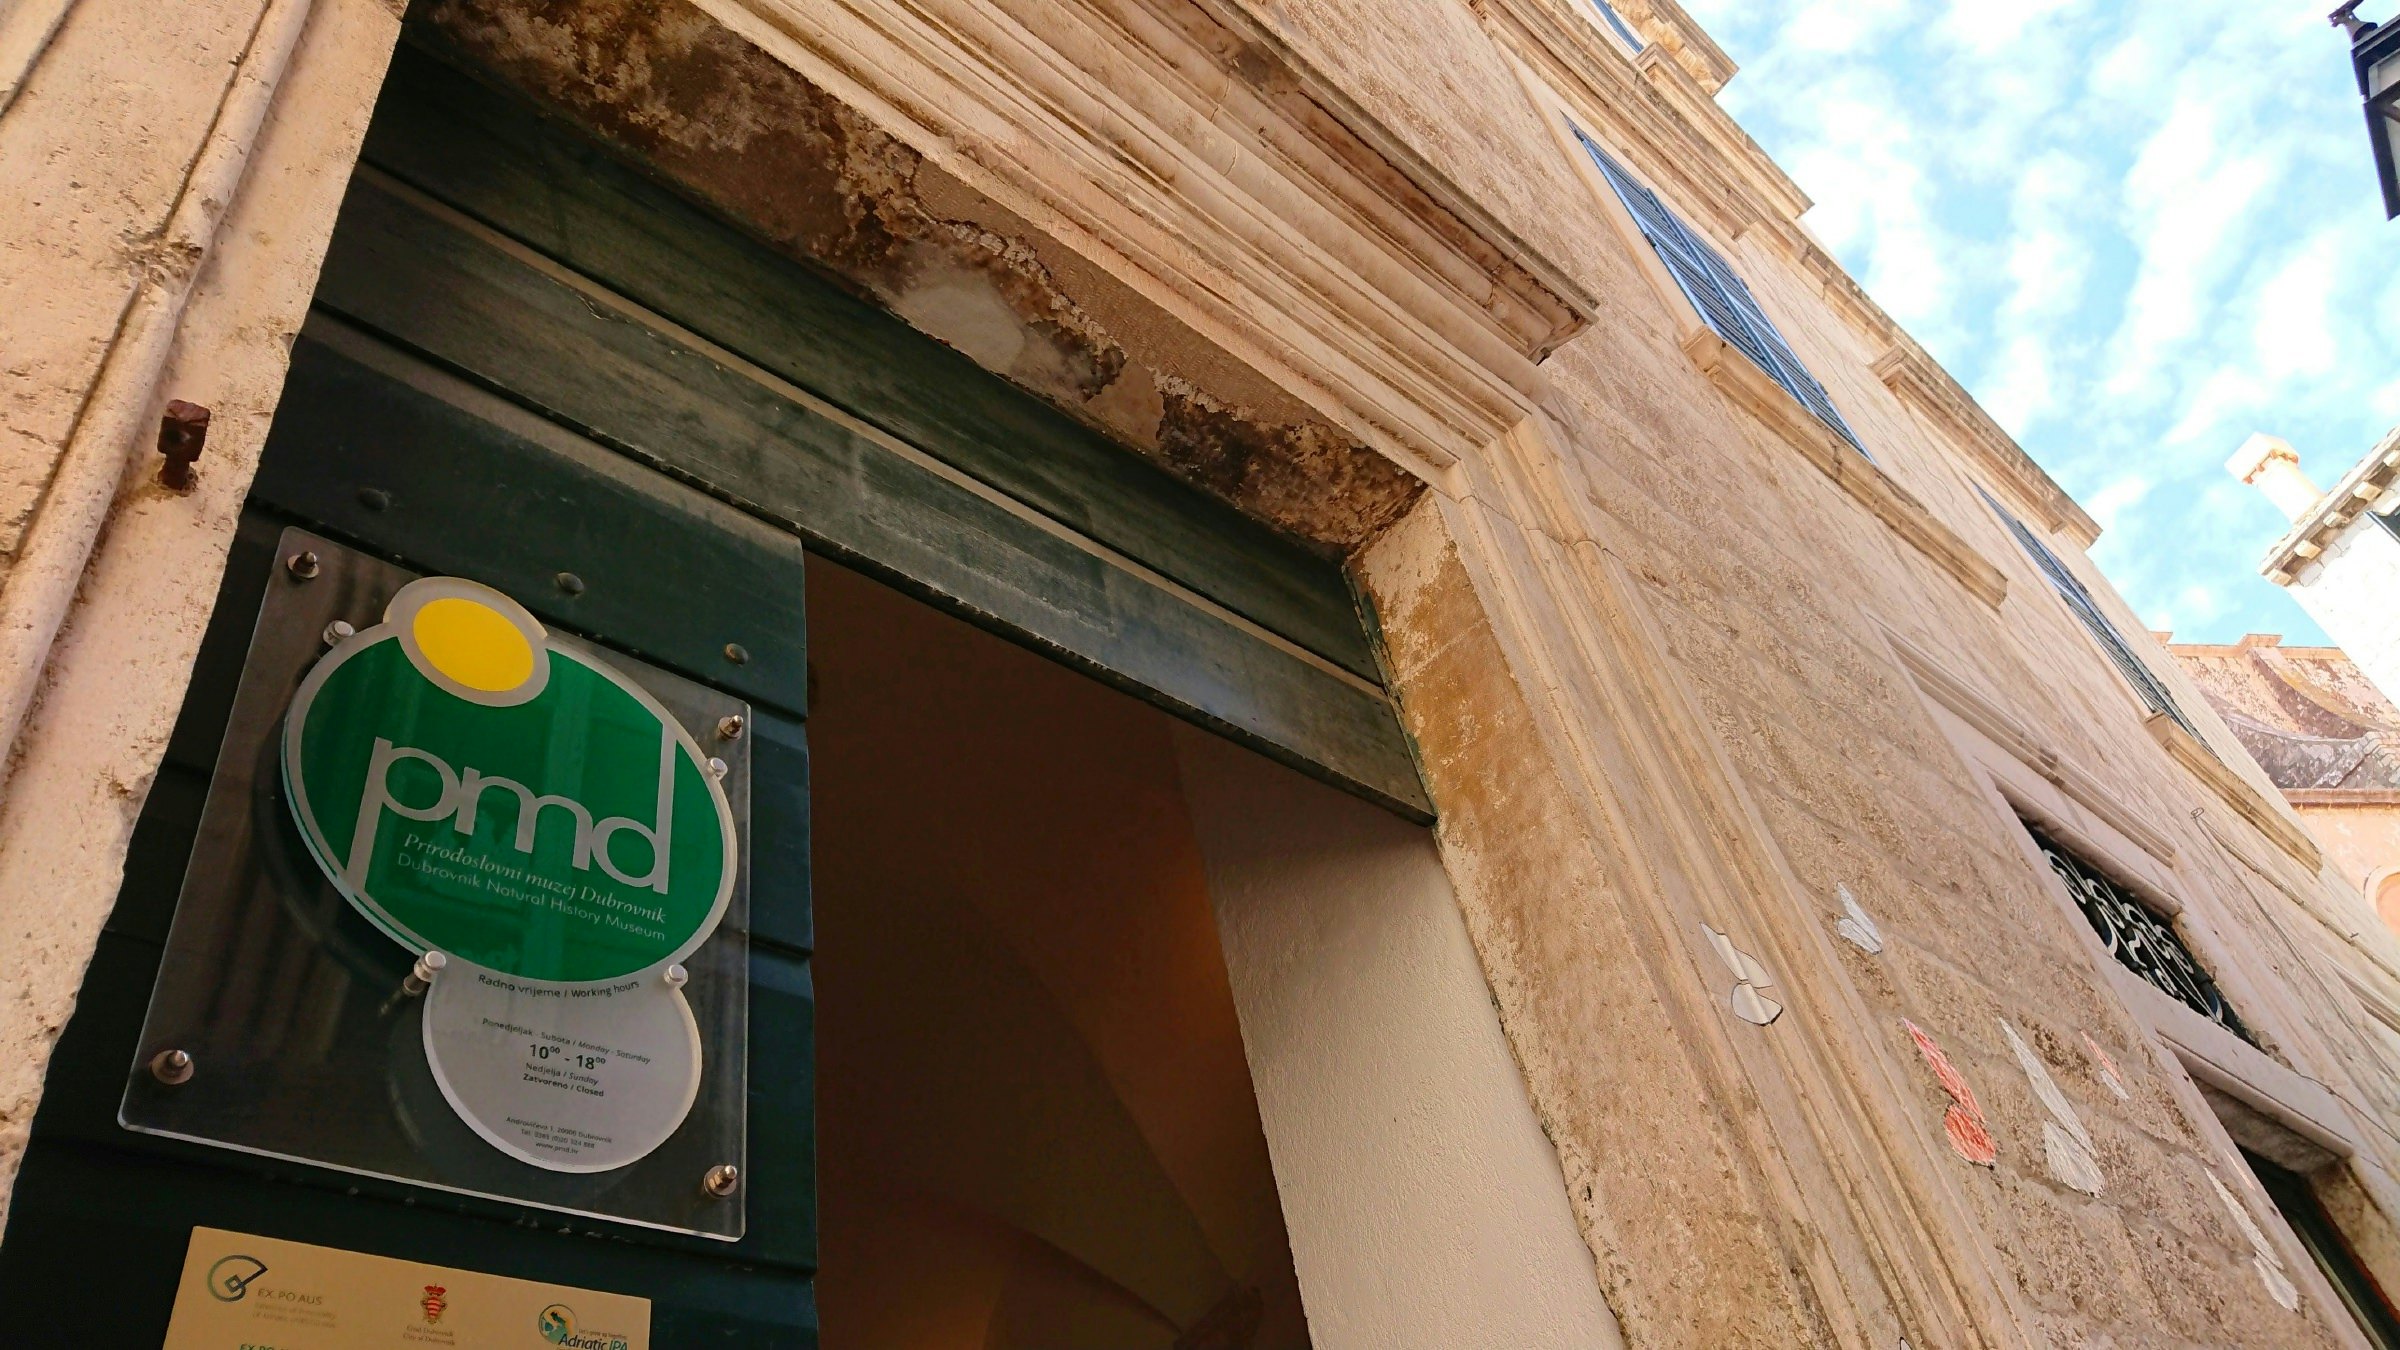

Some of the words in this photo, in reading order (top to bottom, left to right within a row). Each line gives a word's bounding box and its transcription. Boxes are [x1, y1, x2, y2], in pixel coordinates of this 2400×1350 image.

[404, 833, 522, 880] Prirodoslovni
[526, 873, 577, 900] muzej
[580, 885, 667, 924] Dubrovnik
[398, 853, 481, 889] Dubrovnik
[487, 878, 545, 906] Natural
[551, 898, 601, 925] History
[605, 914, 665, 942] Museum
[478, 974, 516, 992] Radno
[518, 985, 561, 998] vrijeme
[571, 986, 612, 998] Working
[613, 980, 640, 993] hours
[482, 1017, 533, 1037] Ponedjeljak
[541, 1031, 571, 1046] Subota
[578, 1041, 610, 1055] Monday
[616, 1049, 652, 1065] Saturday
[523, 1073, 568, 1090] Zatvoreno
[576, 1084, 604, 1097] Closed
[525, 1062, 561, 1077] Nedjelja
[568, 1072, 599, 1086] Sunday
[558, 1333, 607, 1350] Adriatic
